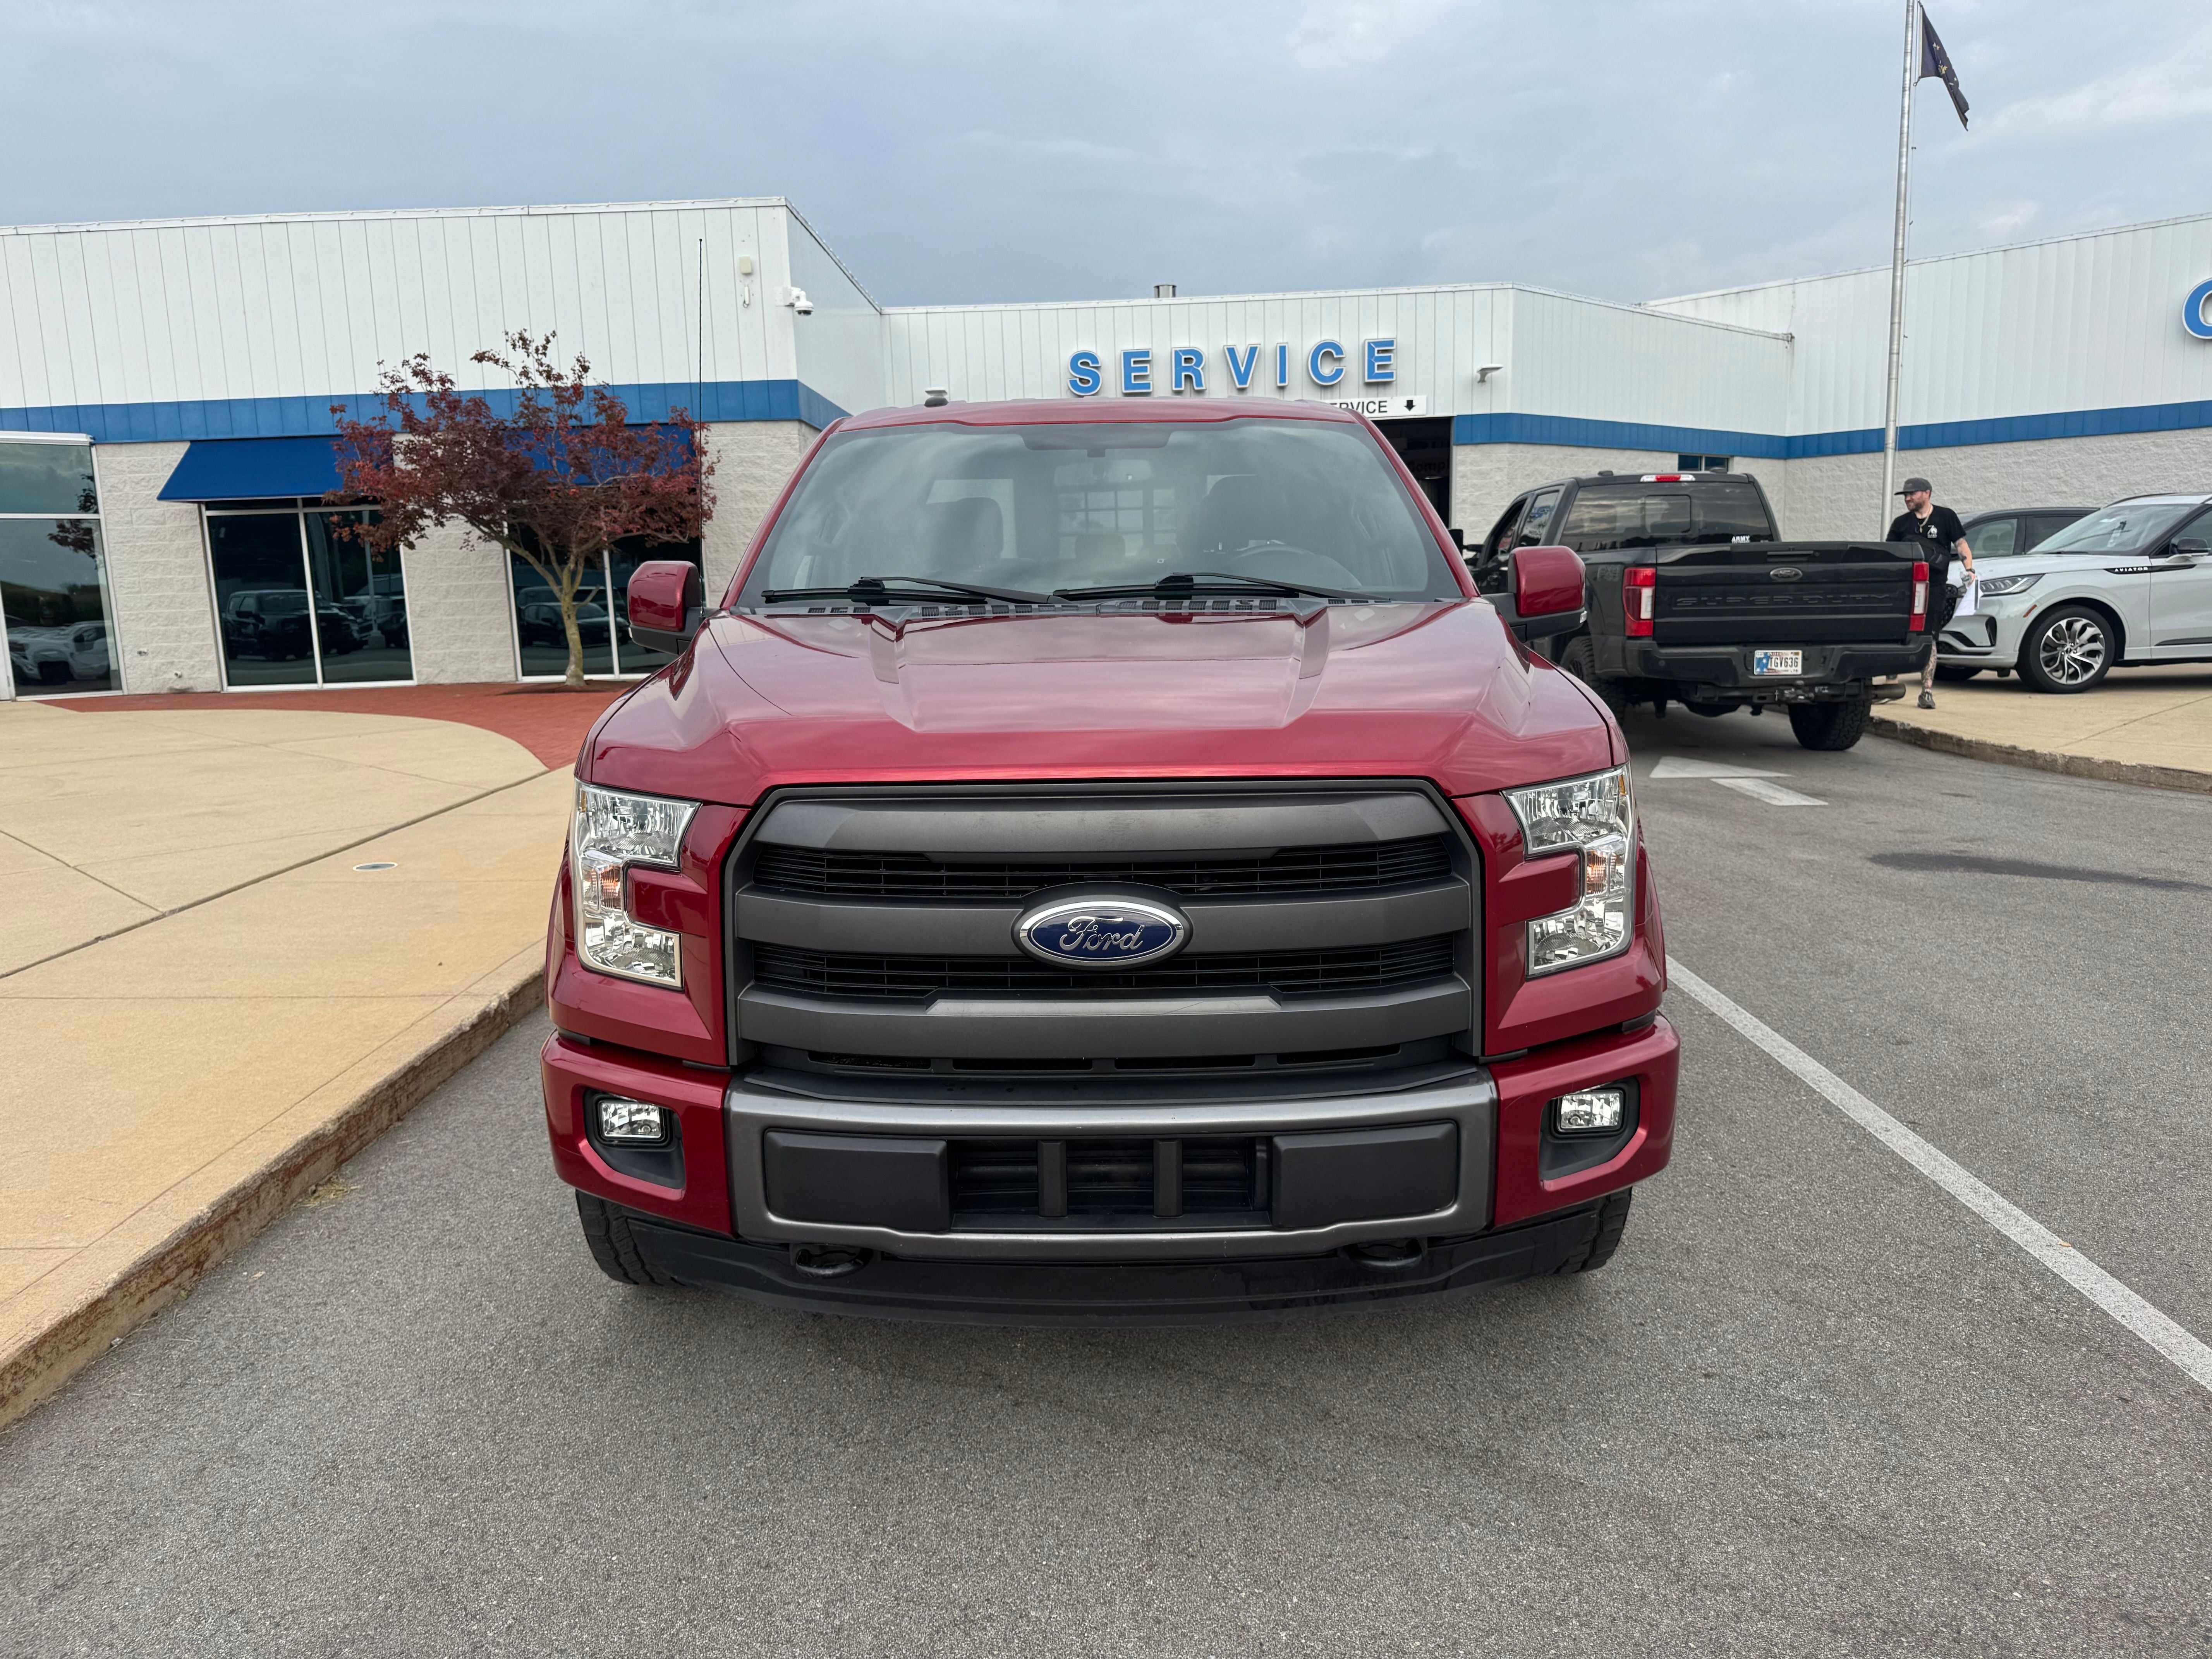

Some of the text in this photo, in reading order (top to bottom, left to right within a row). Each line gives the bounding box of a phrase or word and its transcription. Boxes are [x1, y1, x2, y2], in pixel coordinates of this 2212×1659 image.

[1068, 338, 1396, 396] SERVICE
[1770, 657, 1798, 668] TGV636
[1059, 915, 1145, 951] Ford
